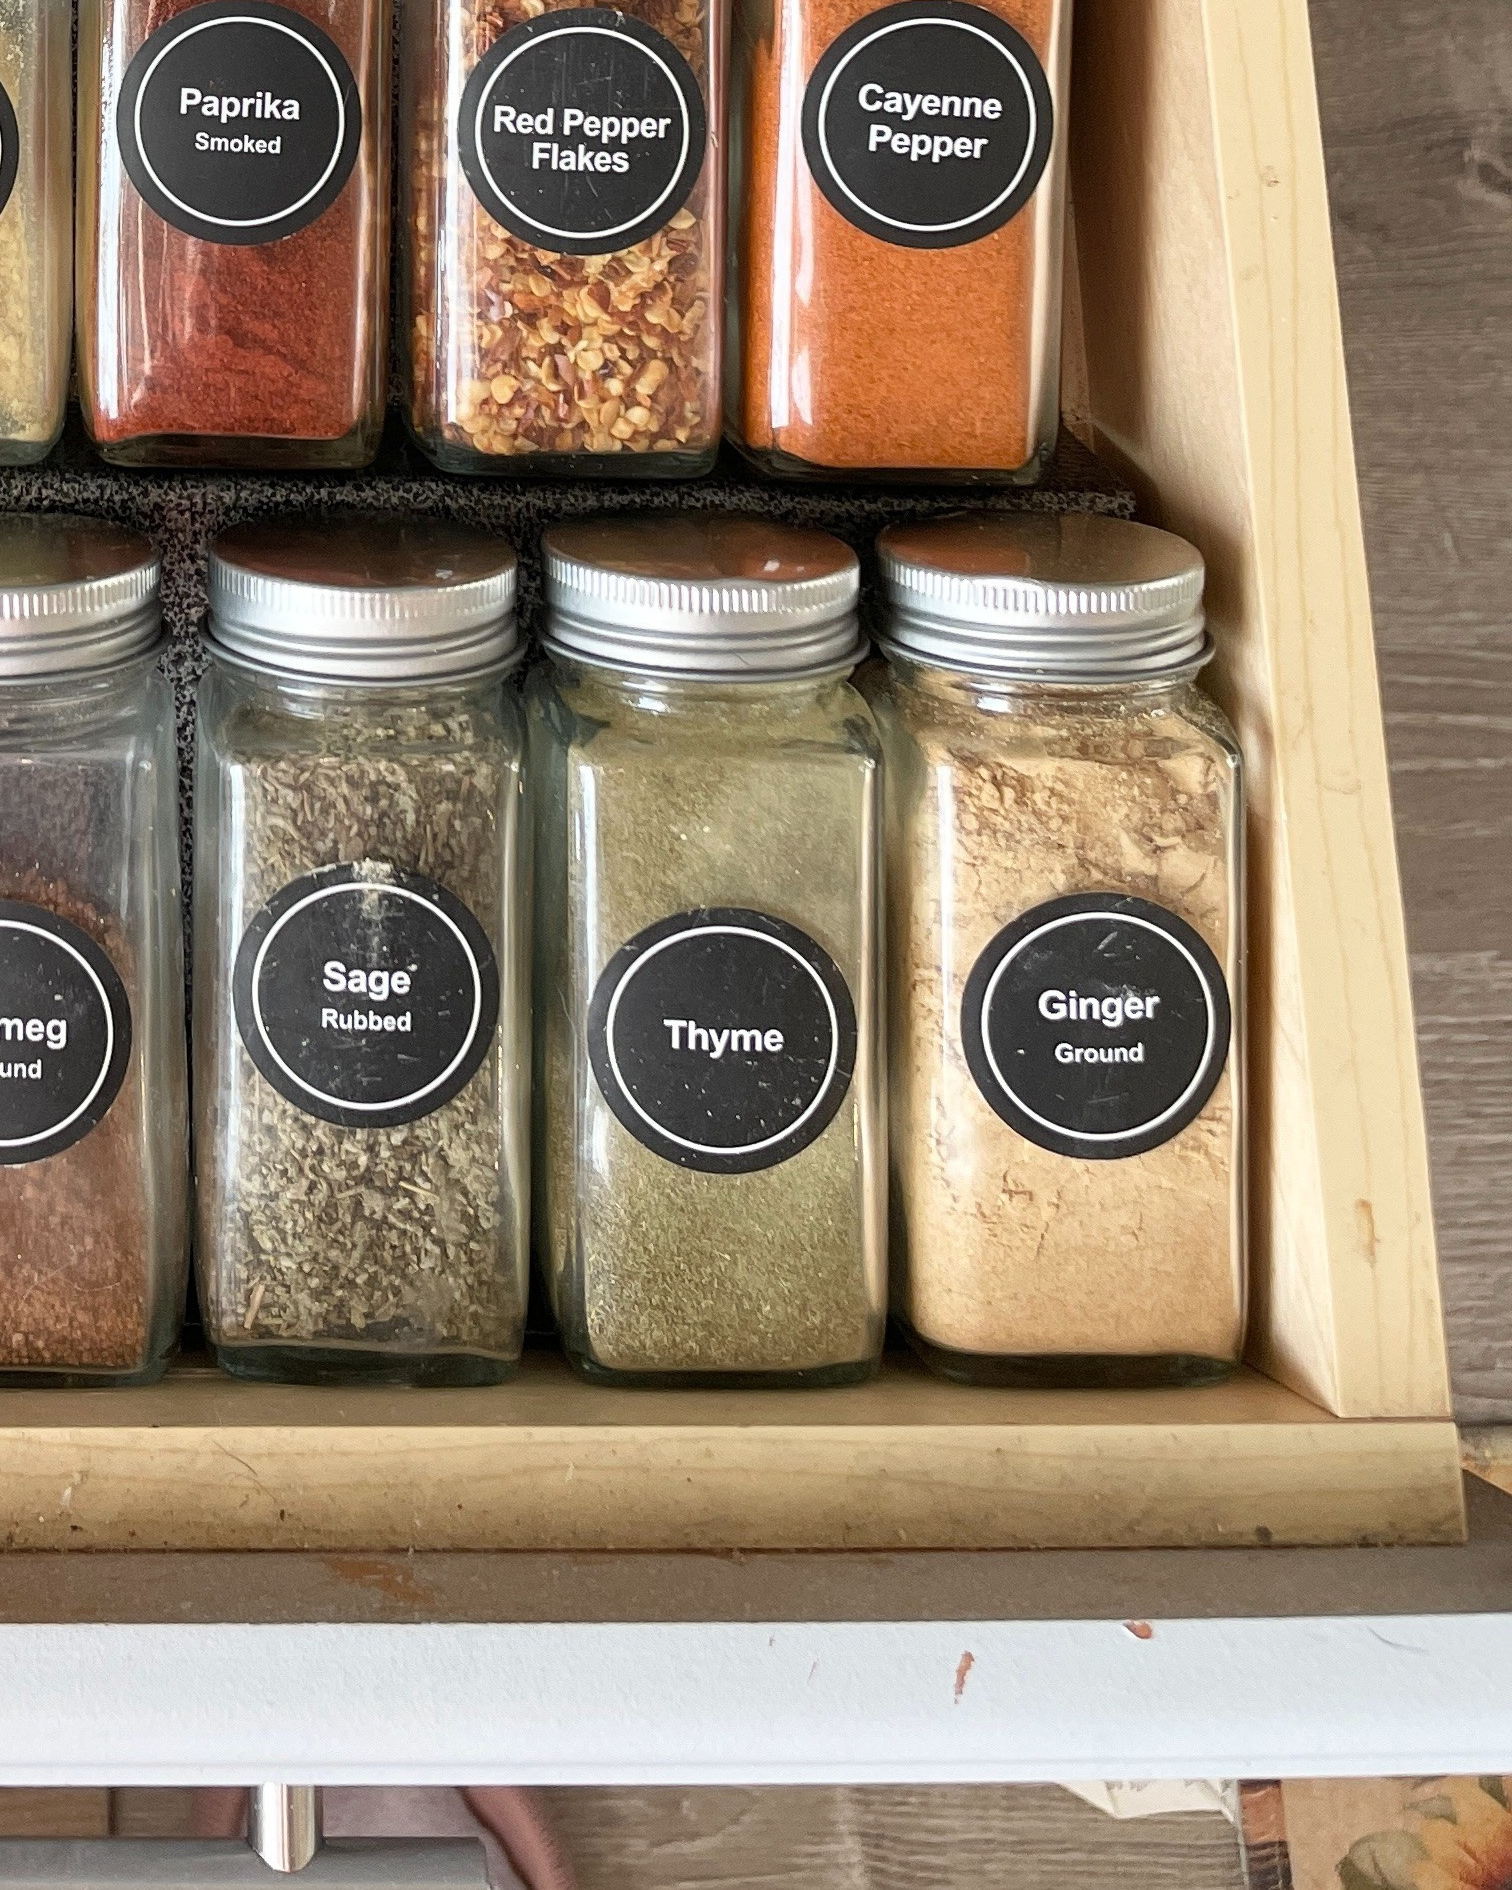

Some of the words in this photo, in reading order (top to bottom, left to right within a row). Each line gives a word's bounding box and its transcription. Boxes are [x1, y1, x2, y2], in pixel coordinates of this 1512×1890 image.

[179, 87, 300, 124] Paprika
[858, 83, 1003, 121] Cayenne
[194, 131, 282, 154] Smoked
[493, 105, 555, 135] Red
[563, 108, 672, 145] Pepper
[868, 123, 989, 163] Pepper
[532, 141, 630, 173] Flakes
[322, 960, 412, 1001] Sage
[321, 1007, 412, 1033] Rubbed
[1038, 989, 1161, 1028] Ginger
[663, 1018, 785, 1060] Thyme
[1054, 1041, 1145, 1064] Ground
